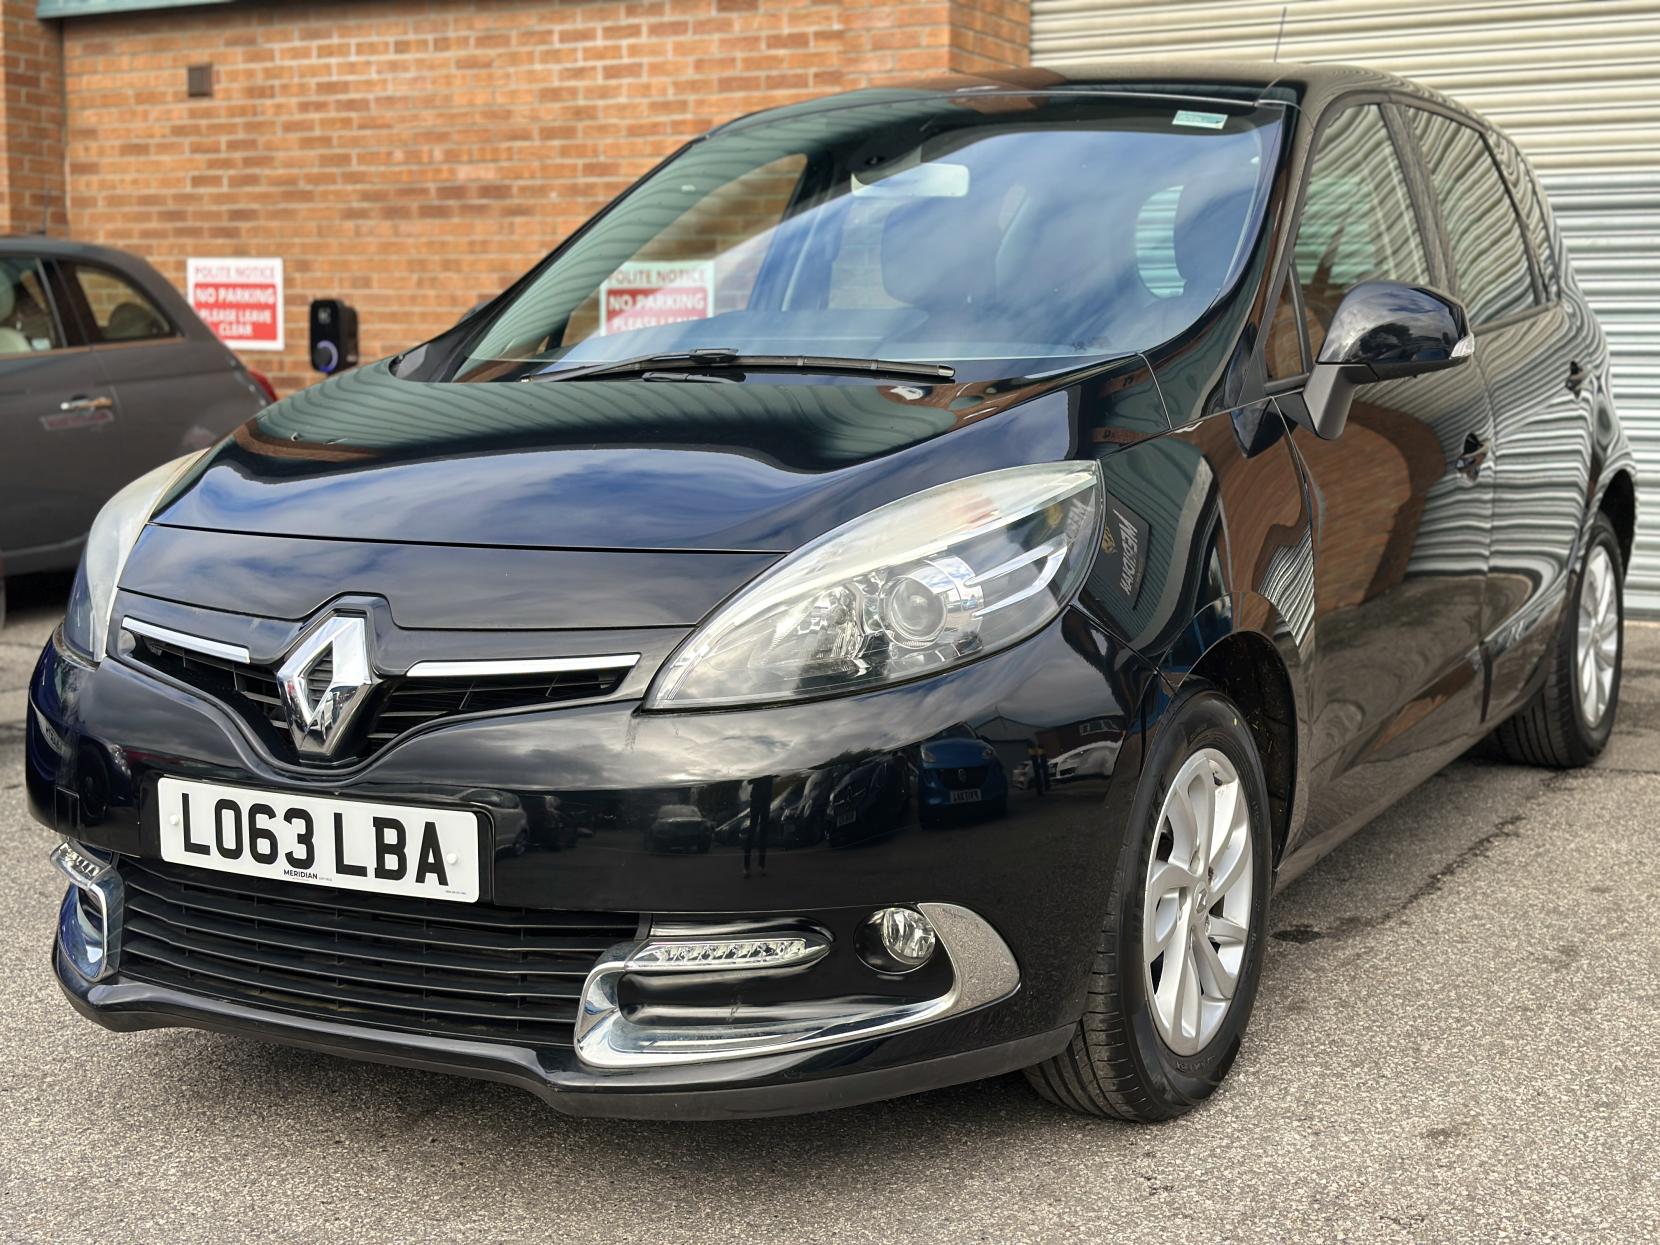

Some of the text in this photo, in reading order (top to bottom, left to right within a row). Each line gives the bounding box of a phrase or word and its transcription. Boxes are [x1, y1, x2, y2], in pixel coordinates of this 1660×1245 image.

[194, 266, 275, 279] POLITE NOTICE
[656, 270, 705, 283] NOTICE
[194, 288, 275, 304] NO PARKING
[608, 293, 704, 311] NO PARKING
[199, 308, 272, 323] PLEASE LEAVE
[219, 323, 252, 337] CLEAR
[181, 792, 449, 887] LO63 LBA
[283, 869, 318, 880] MERIDIAN
